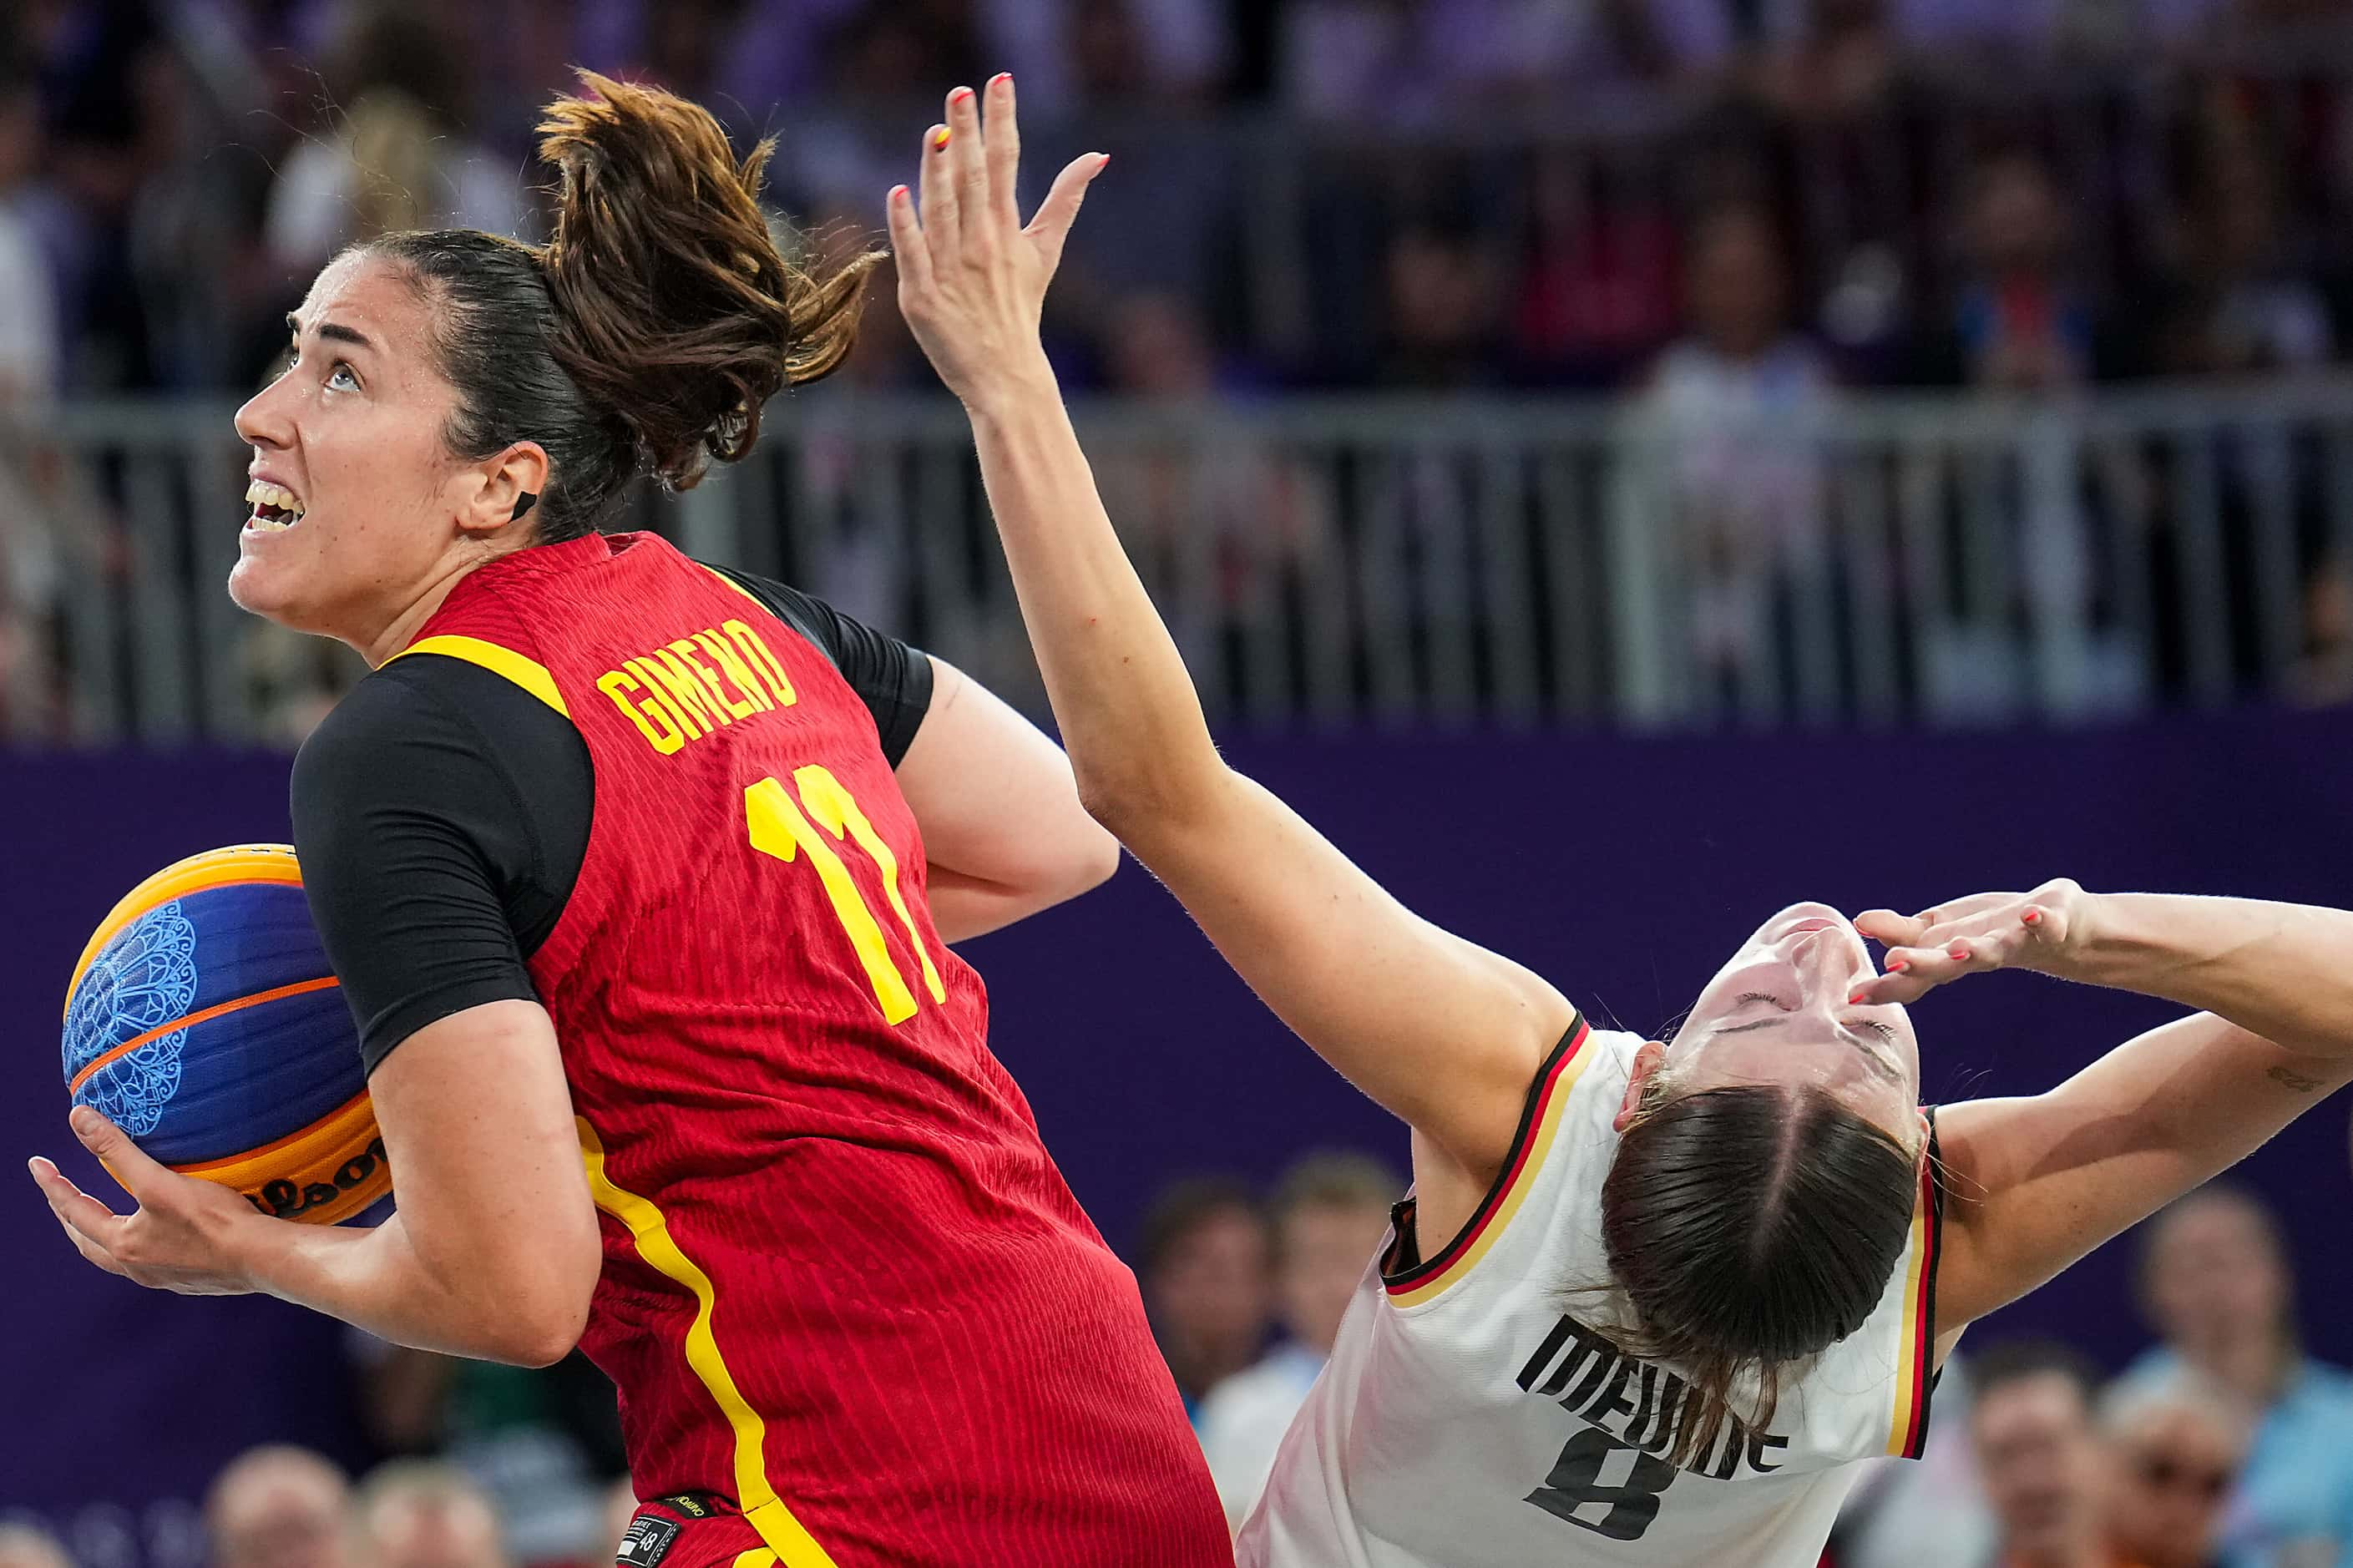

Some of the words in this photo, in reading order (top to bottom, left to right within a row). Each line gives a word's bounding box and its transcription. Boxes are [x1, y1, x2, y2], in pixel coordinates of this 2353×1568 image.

[596, 619, 797, 755] GIMENO
[745, 764, 945, 1026] 11
[1523, 1427, 1681, 1541] 8
